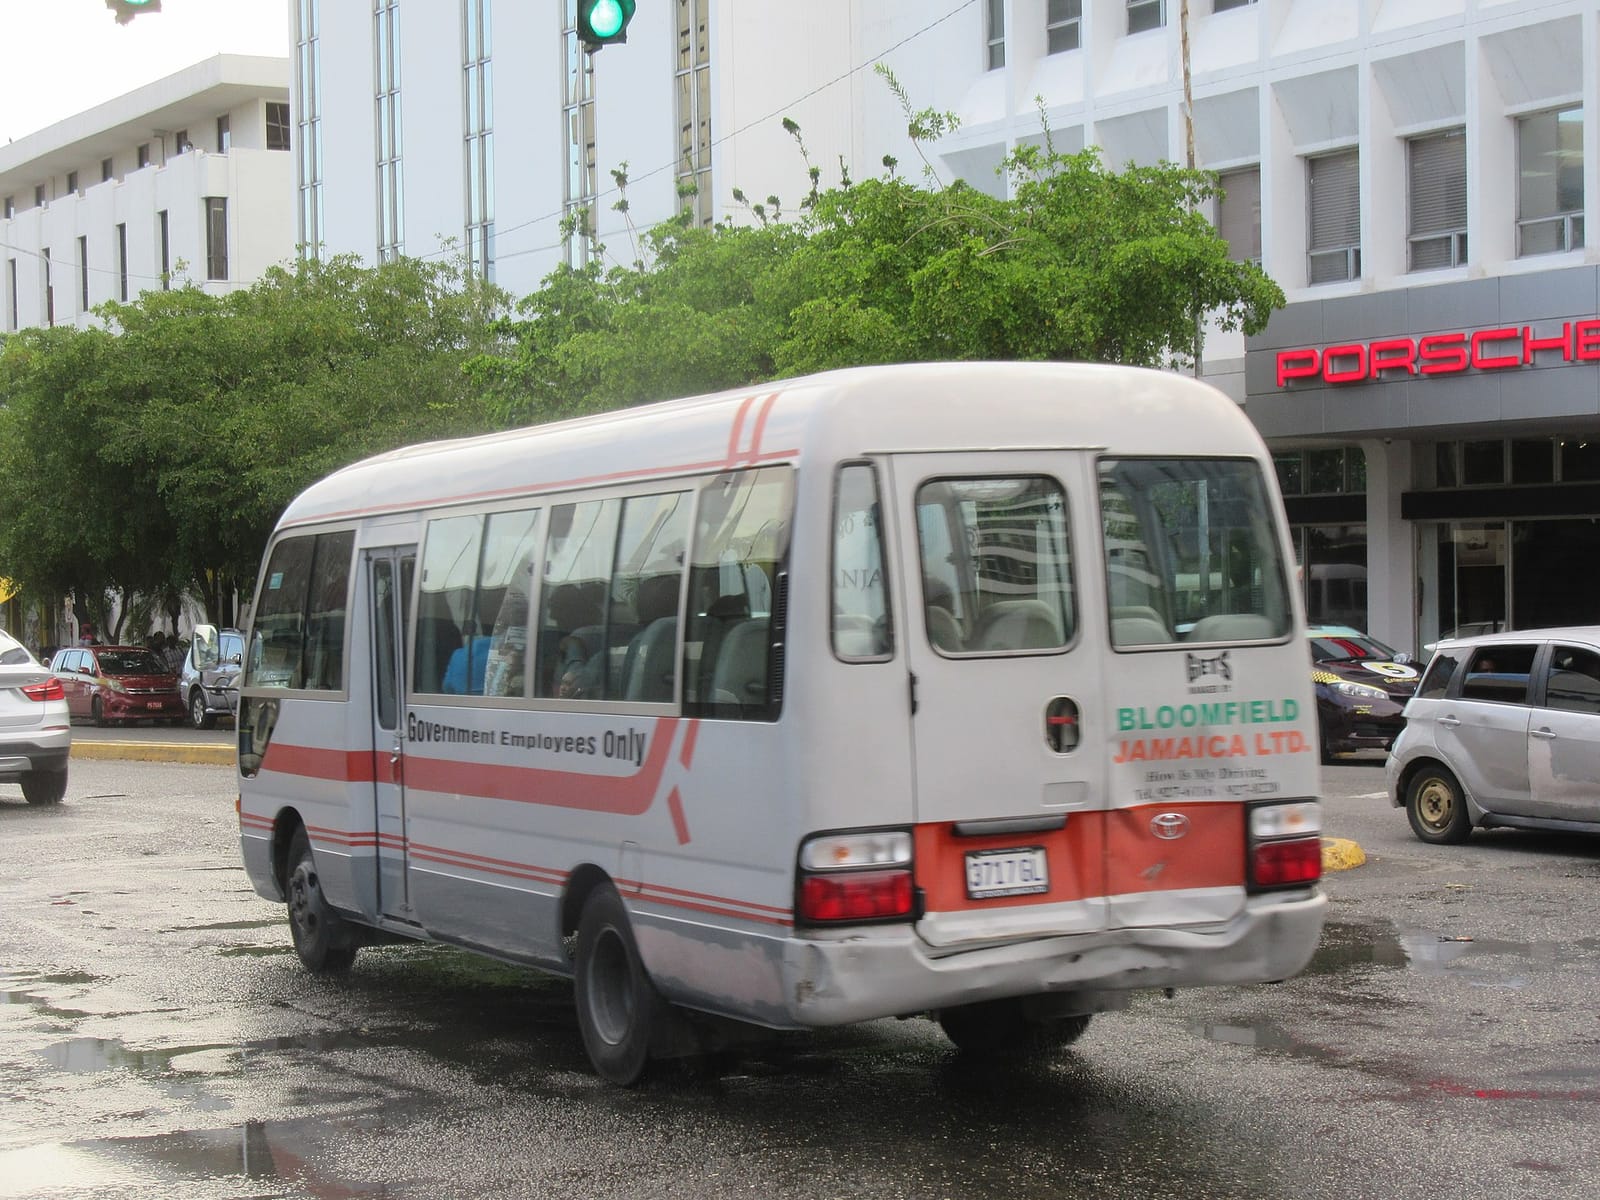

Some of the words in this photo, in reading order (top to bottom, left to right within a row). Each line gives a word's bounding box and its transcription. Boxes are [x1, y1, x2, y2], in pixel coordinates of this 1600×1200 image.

[1276, 319, 1600, 387] PORSCHE
[1117, 699, 1299, 731] BLOOMFIELD
[407, 711, 496, 745] Government
[501, 731, 596, 755] Employees
[603, 728, 647, 767] Only
[1113, 734, 1248, 764] JAMAICA
[1255, 730, 1312, 756] LTD.
